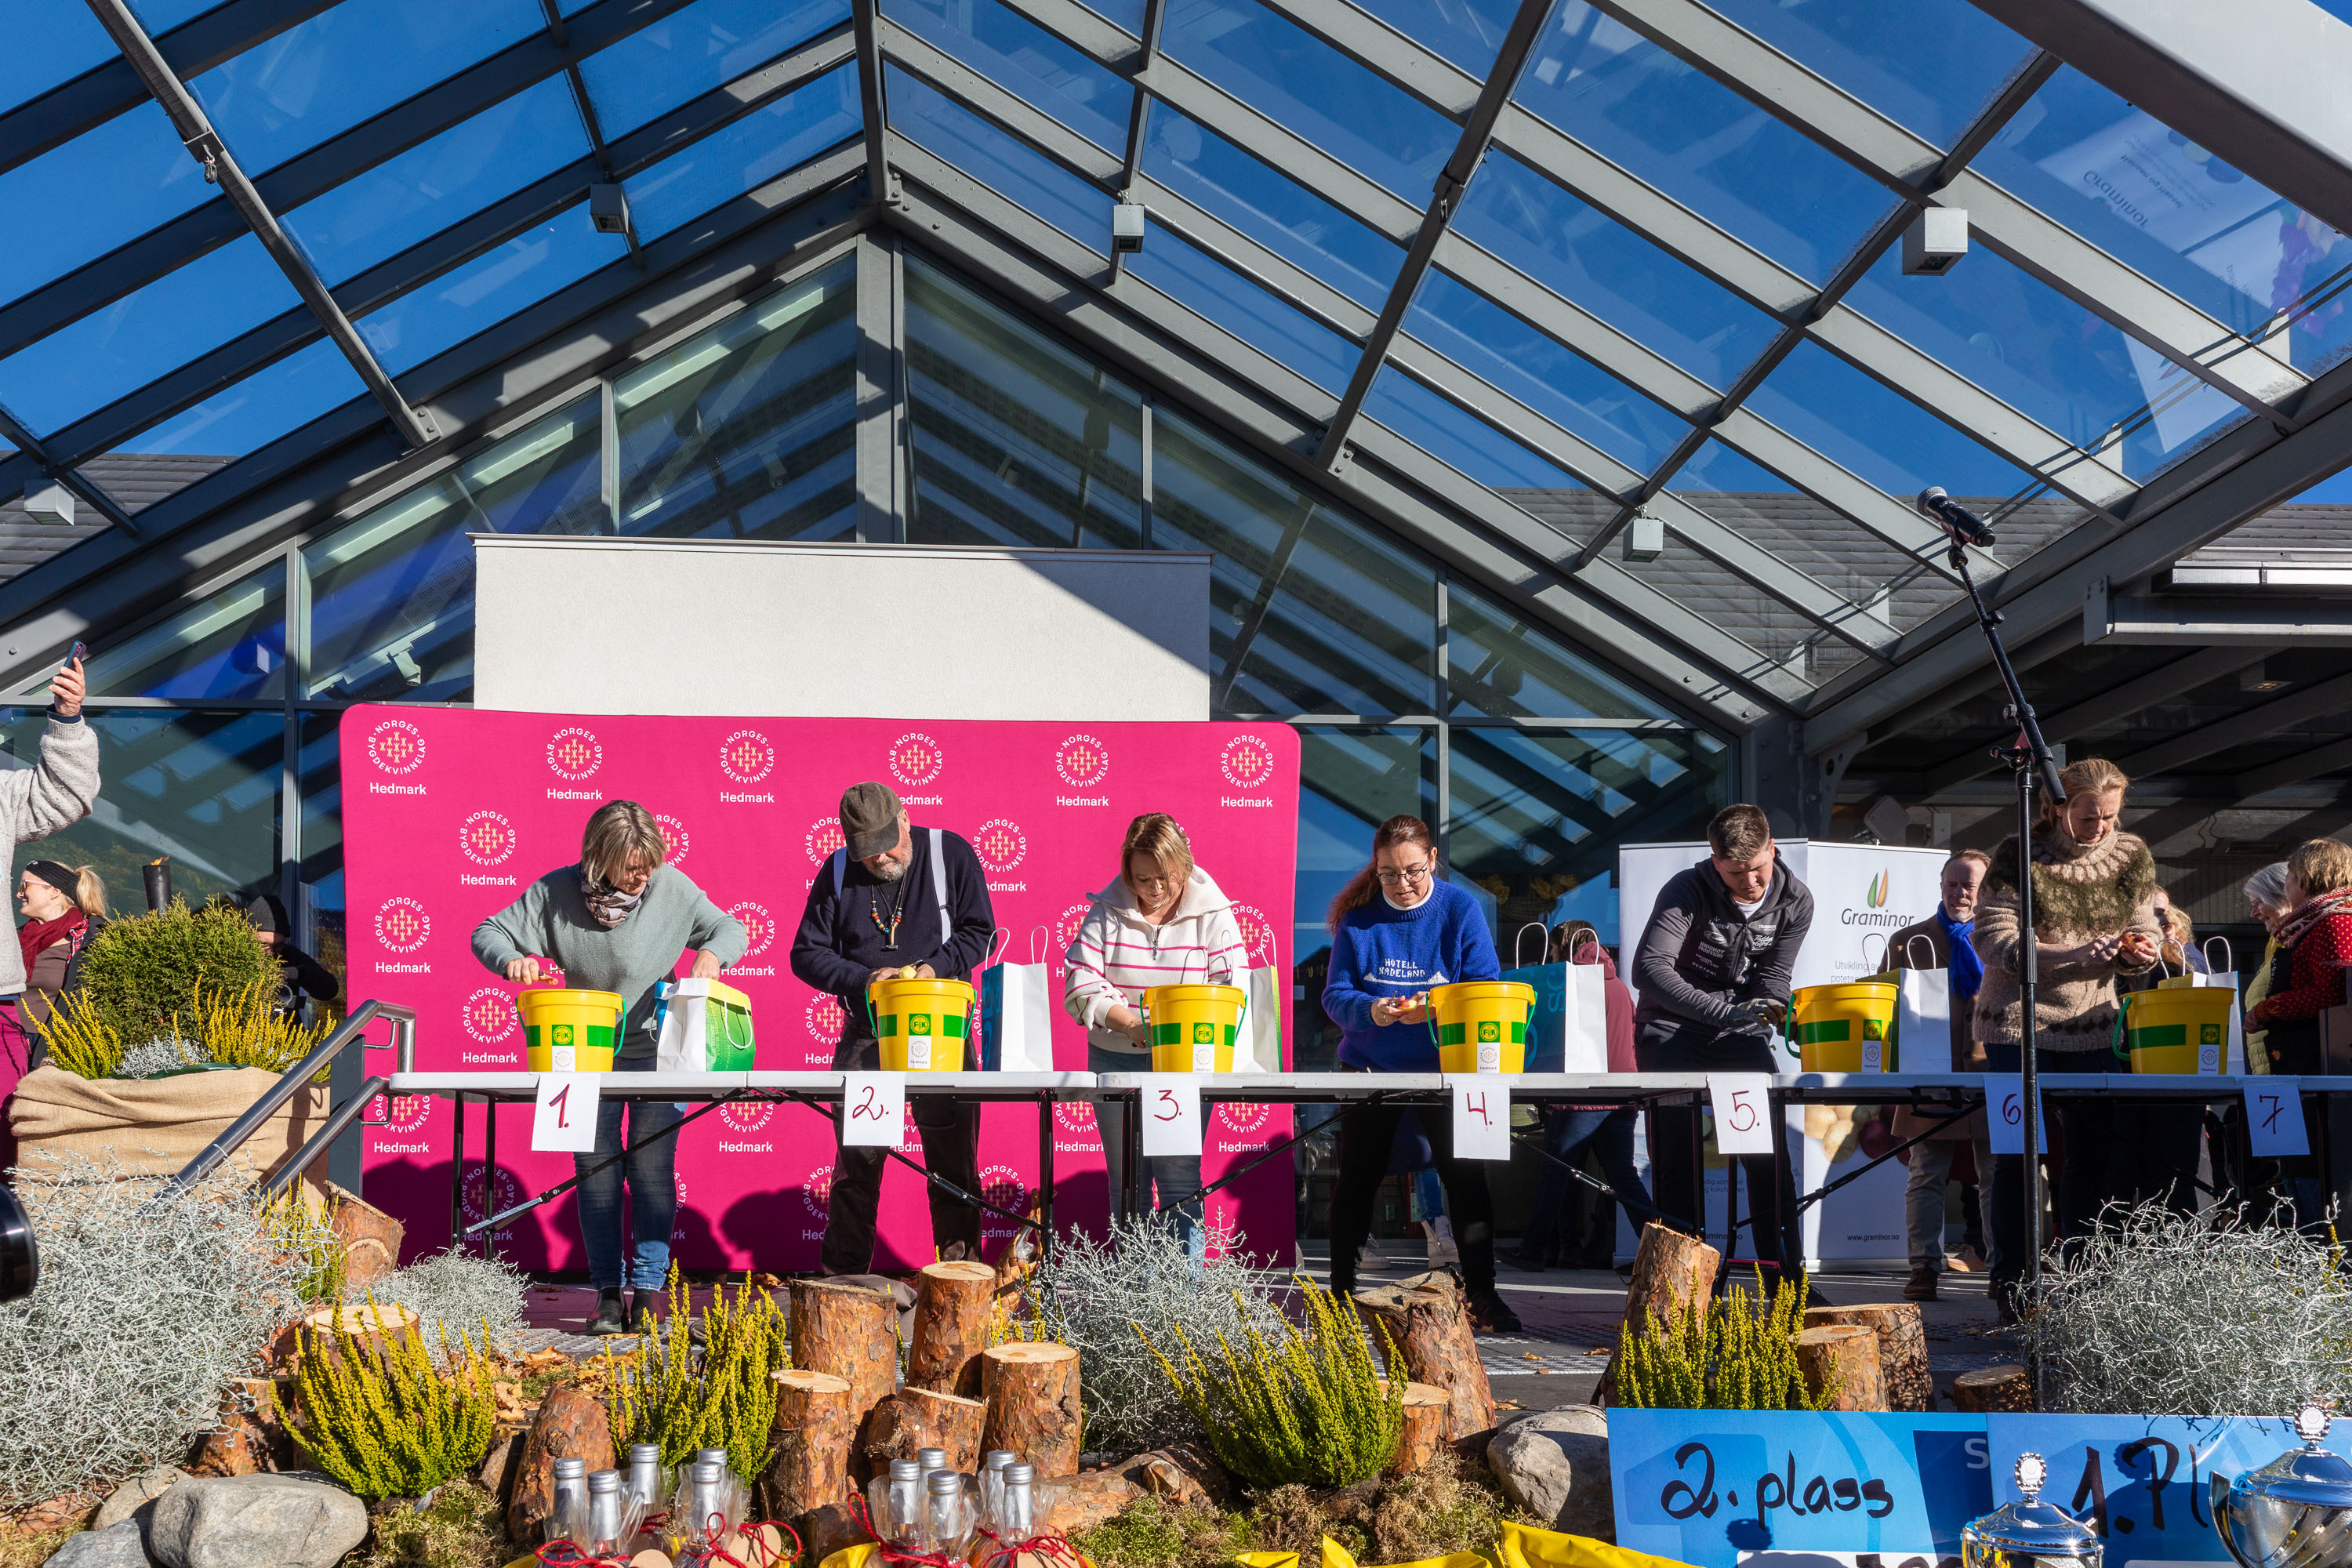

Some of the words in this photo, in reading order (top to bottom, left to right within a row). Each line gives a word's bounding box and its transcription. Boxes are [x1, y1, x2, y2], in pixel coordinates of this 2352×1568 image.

[375, 720, 418, 735] NORGES
[554, 728, 595, 741] NORGES
[727, 731, 767, 744] NORGES
[895, 733, 935, 746] NORGES
[1062, 735, 1101, 748] NORGES
[1227, 735, 1266, 749] NORGES
[368, 737, 426, 775] BYGDEKVINNELAG
[546, 744, 602, 780] BYGDEKVINNELAG
[720, 747, 774, 783] BYGDEKVINNELAG
[889, 750, 942, 786] BYGDEKVINNELAG
[1056, 752, 1108, 787] BYGDEKVINNELAG
[1221, 753, 1273, 788] BYGDEKVINNELAG
[370, 782, 426, 794] Hedmark
[547, 789, 602, 800] Hedmark
[720, 792, 774, 803] Hedmark
[899, 795, 942, 805] edmark
[1057, 796, 1109, 806] Hedmark
[1221, 797, 1272, 807] Hedmark
[466, 811, 508, 825] NORGES
[653, 815, 681, 829] RGES
[812, 818, 840, 830] NORG
[980, 819, 1019, 833] NORGES
[459, 828, 515, 866] BYGDEKVINNELAG
[462, 874, 517, 885] Hedmark
[985, 881, 1026, 891] edmark
[381, 897, 423, 911] NORGES
[1062, 905, 1090, 918] NORG
[1232, 906, 1264, 920] ORGES
[1841, 908, 1915, 927] Graminor
[375, 916, 430, 953] BYGDEKVINNELAG
[744, 919, 775, 956] VINNELAG
[376, 962, 430, 973] Hedmark
[1385, 958, 1417, 969] HOTELL
[1835, 960, 1869, 973] Utvikling
[470, 988, 510, 1002] NORGES
[463, 1006, 517, 1043] BYGDEKVINNELAG
[805, 1008, 840, 1044] BYGDEKVI
[463, 1052, 517, 1062] Hedmark
[549, 1083, 570, 1128] 1.
[852, 1086, 890, 1120] 2.
[1153, 1089, 1182, 1121] 3.
[1467, 1092, 1494, 1127] 4.
[720, 1103, 774, 1133] YGDEKVINNELA
[1055, 1103, 1098, 1133] YGDEKVINN
[1730, 1091, 1760, 1131] 5.
[2259, 1094, 2285, 1135] 7
[1218, 1104, 1269, 1133] YGDEKVINNELA
[375, 1142, 430, 1153] Hedmark
[720, 1142, 773, 1152] Hedmark
[1218, 1142, 1270, 1152] Hedmark
[467, 1166, 508, 1181] NOES
[810, 1166, 834, 1181] NOR
[978, 1165, 1018, 1180] NORGES
[463, 1229, 513, 1241] edark
[982, 1228, 1023, 1237] edmar
[1847, 1233, 1900, 1242] www.graminor.no
[1661, 1442, 1739, 1519] 2.
[1757, 1450, 1894, 1530] plass
[2071, 1445, 2135, 1538] 1.
[2122, 1436, 2209, 1530] Pl
